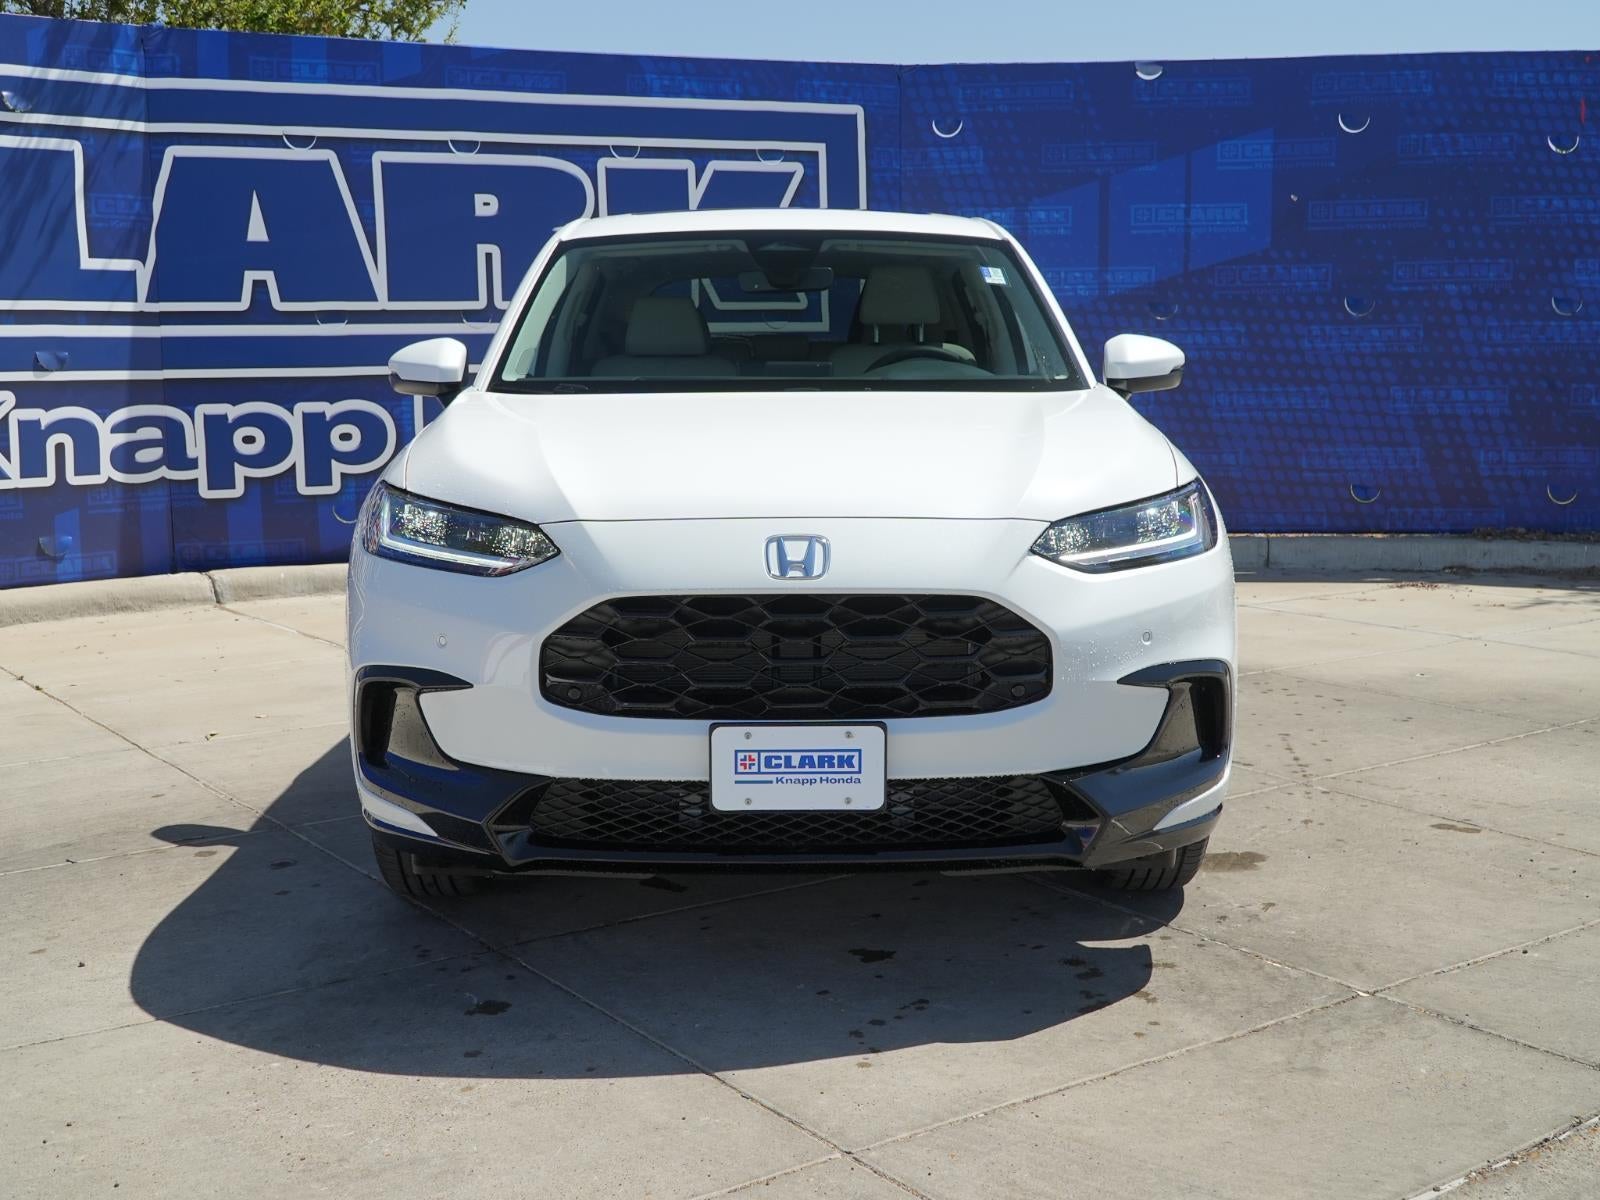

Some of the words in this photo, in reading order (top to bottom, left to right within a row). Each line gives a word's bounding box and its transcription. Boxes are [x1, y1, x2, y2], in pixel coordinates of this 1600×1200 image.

[1157, 207, 1243, 222] CLARK
[1208, 224, 1247, 233] Honda
[763, 754, 856, 769] CLARK
[775, 776, 818, 786] Knapp
[819, 776, 862, 785] Honda
